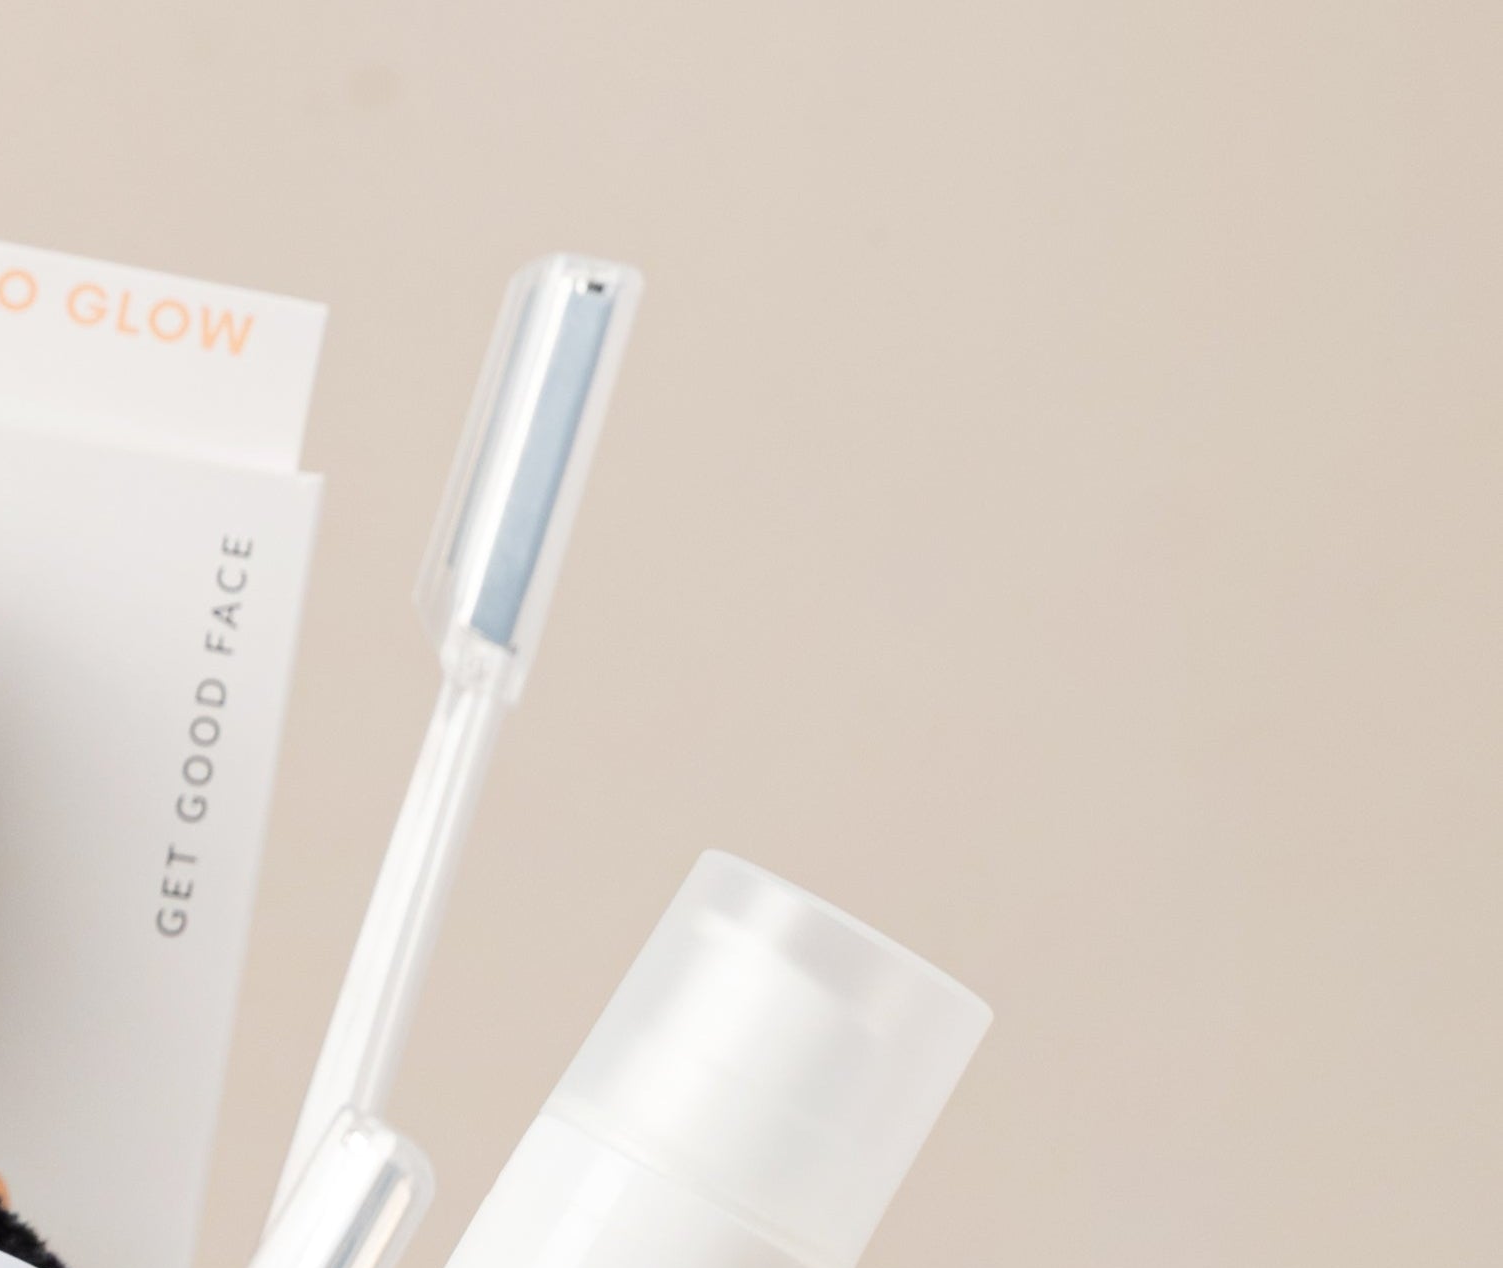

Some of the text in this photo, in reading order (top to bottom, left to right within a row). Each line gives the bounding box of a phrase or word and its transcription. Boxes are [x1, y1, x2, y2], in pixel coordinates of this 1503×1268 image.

[67, 283, 256, 357] GLOW
[155, 533, 254, 938] GET GOOD FACE
